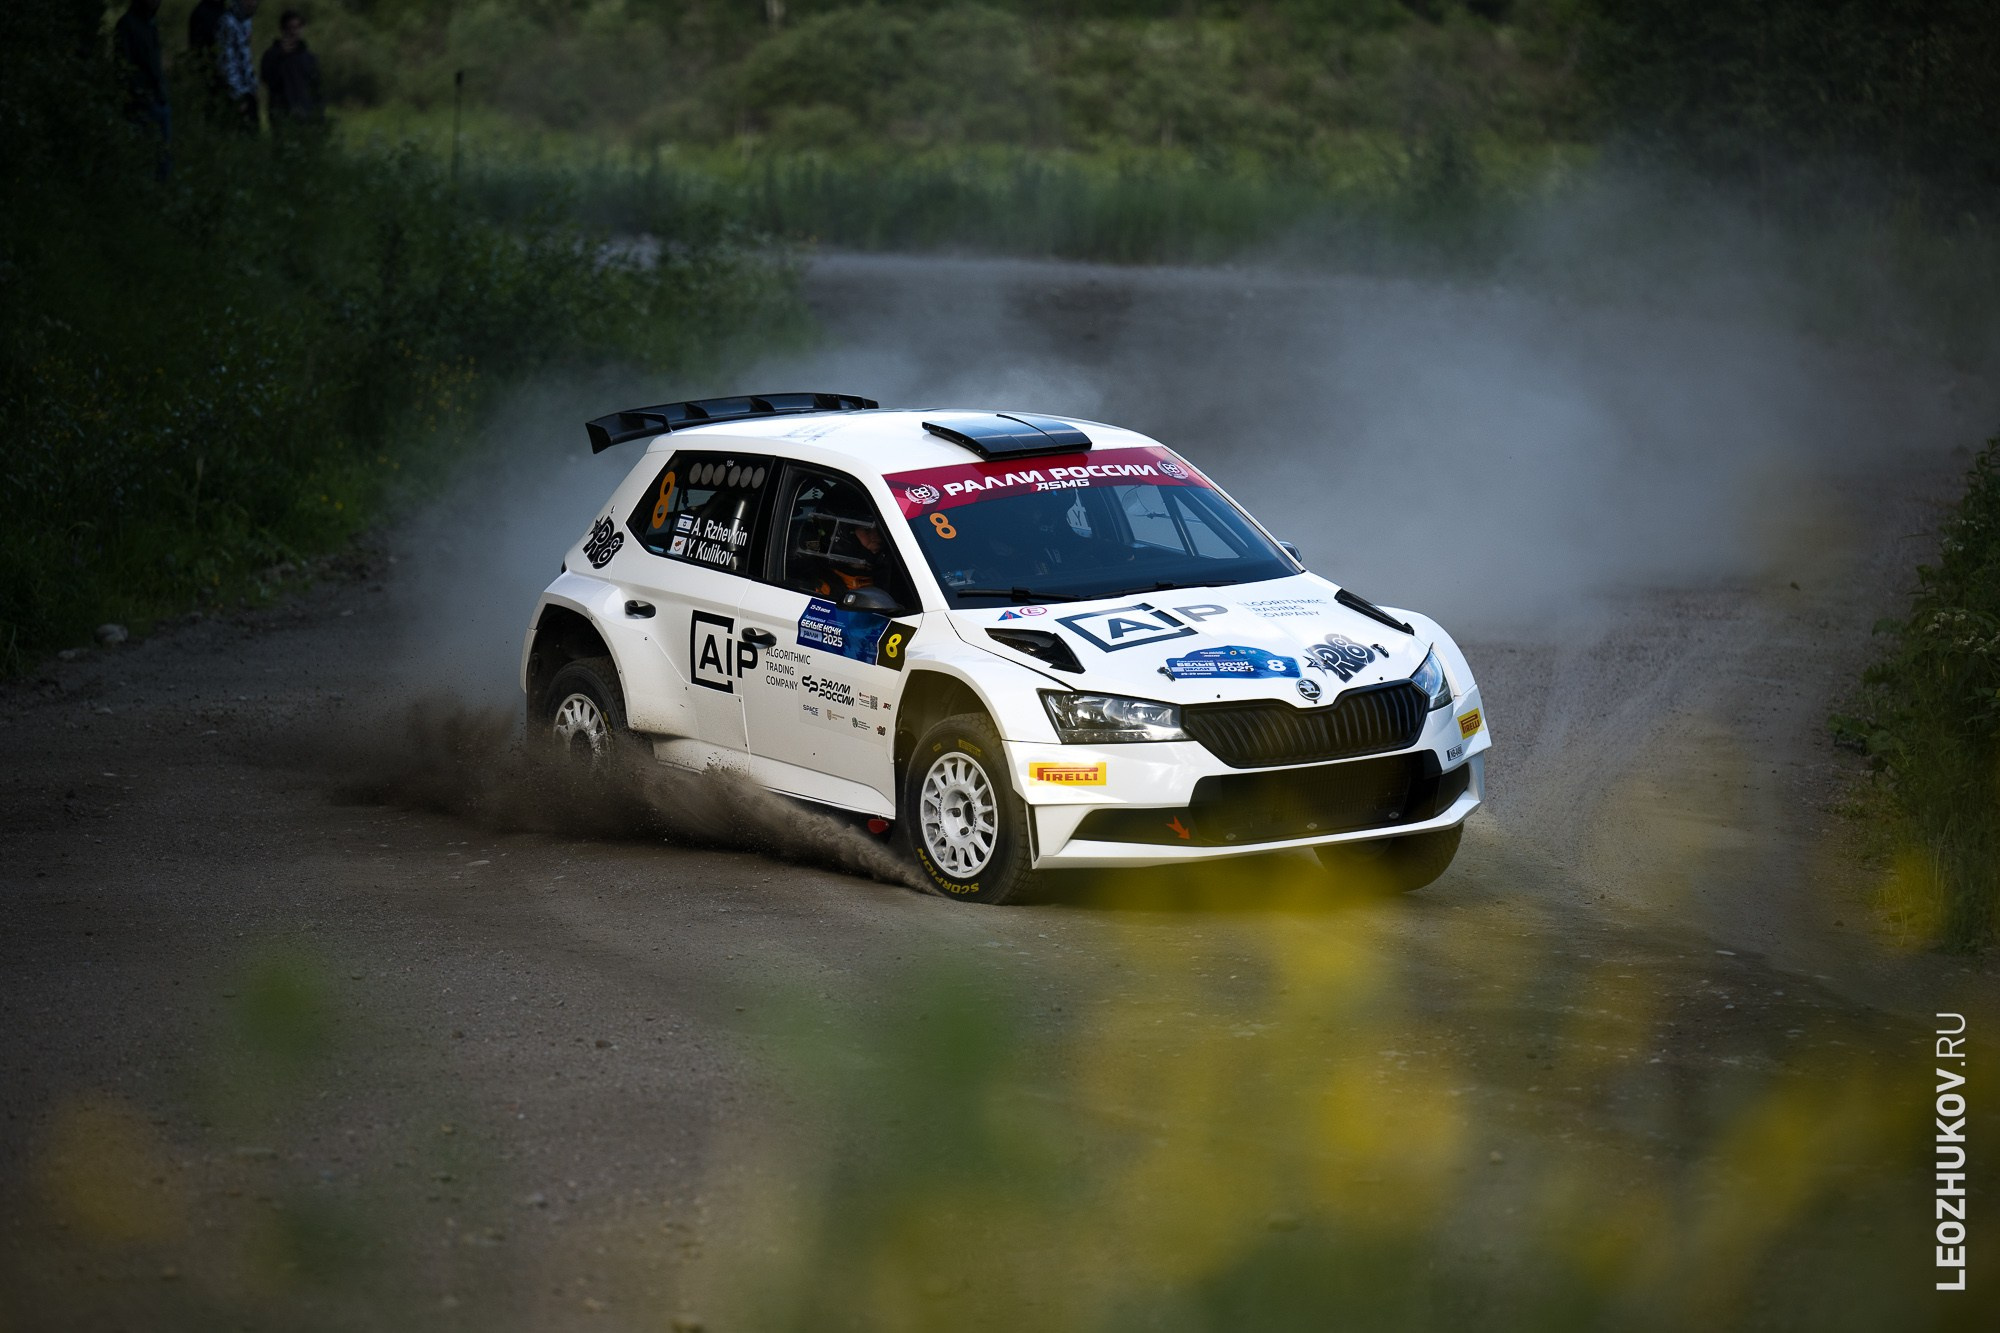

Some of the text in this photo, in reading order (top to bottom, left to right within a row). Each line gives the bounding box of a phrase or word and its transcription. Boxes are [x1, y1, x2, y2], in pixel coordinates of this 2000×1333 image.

[943, 463, 1160, 497] РАЛЛИ РОССИИ
[652, 471, 676, 529] 8
[691, 519, 748, 546] A. Rzhevkin
[929, 512, 957, 539] 8
[686, 538, 733, 567] Y. Kulikov
[801, 618, 823, 632] БЕЛЫЕ
[822, 625, 842, 636] НОЧИ
[822, 633, 843, 648] 2025
[885, 633, 902, 658] 8
[766, 647, 811, 666] ALGORITHMIC
[1267, 659, 1287, 672] 8
[765, 661, 795, 676] TRADING
[765, 675, 799, 691] COMPANY
[819, 678, 851, 695] РАЛЛИ
[818, 688, 855, 707] РОССИИ
[1460, 713, 1480, 735] PIRELLI
[1037, 767, 1099, 781] PIRELLI
[916, 847, 980, 895] SCORPION
